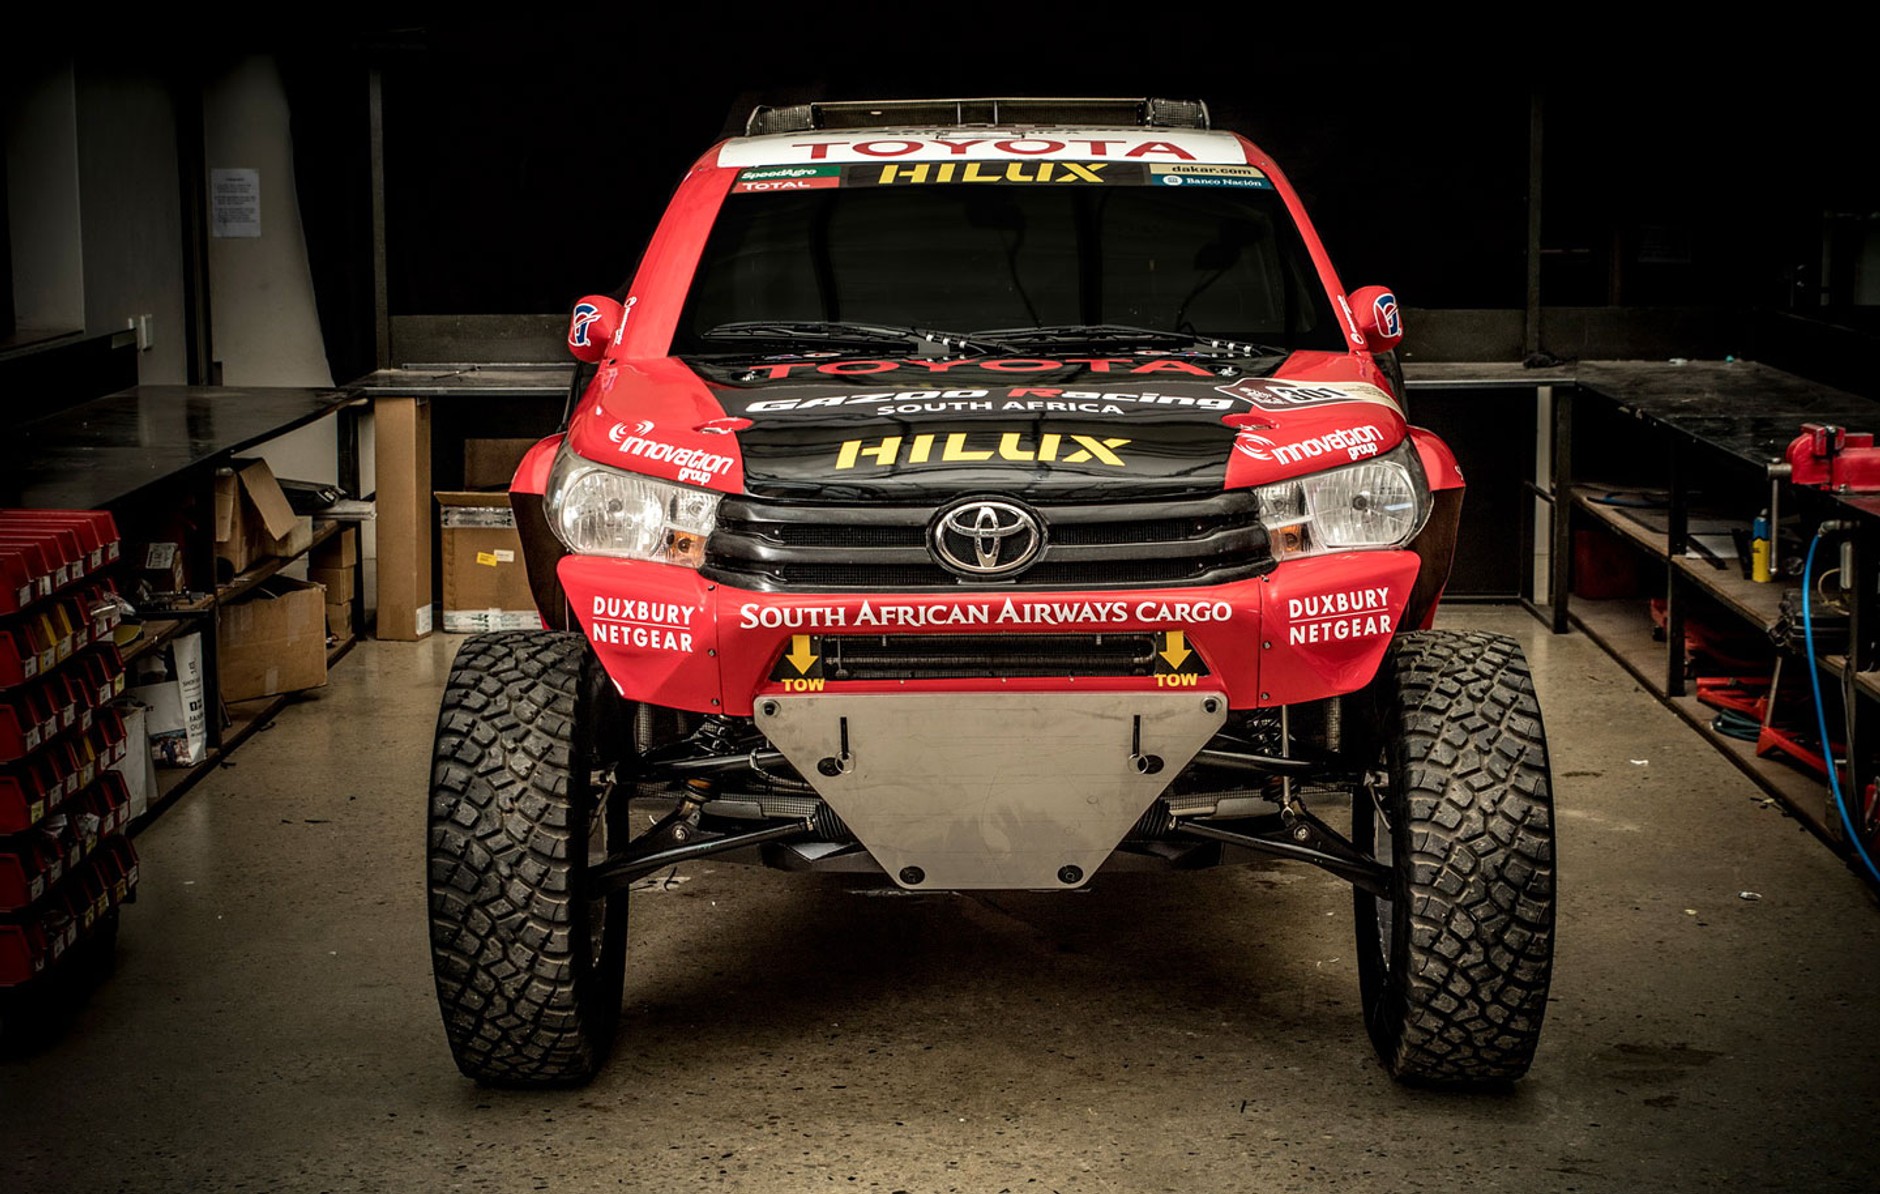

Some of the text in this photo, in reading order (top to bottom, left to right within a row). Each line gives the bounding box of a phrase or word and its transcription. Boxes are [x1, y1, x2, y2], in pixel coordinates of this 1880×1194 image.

[792, 139, 1198, 161] TOYOTA
[741, 168, 817, 180] SpeedAgro
[878, 162, 1108, 184] HILUX
[1172, 166, 1252, 175] dakar.com
[742, 181, 811, 191] TOTAL
[1186, 177, 1220, 186] Banco
[748, 358, 1216, 379] TOYOTA
[745, 389, 990, 413] GAZOO
[1006, 388, 1233, 411] Racing
[1276, 387, 1348, 401] 301
[877, 400, 1126, 416] SOUTH AFRICA
[619, 436, 734, 475] innovation
[834, 433, 1133, 470] HILUX
[1270, 425, 1384, 466] innovation
[1348, 443, 1378, 461] group
[678, 467, 711, 486] group
[593, 595, 695, 626] DUXBURY
[740, 598, 1233, 629] SOUTH AFRICAN AIRWAYS CARGO
[1288, 587, 1389, 619] DUXBURY
[593, 624, 693, 653] NETGEAR
[1289, 614, 1392, 646] NETGEAR
[781, 678, 826, 692] TOW
[1154, 672, 1198, 688] TOW
